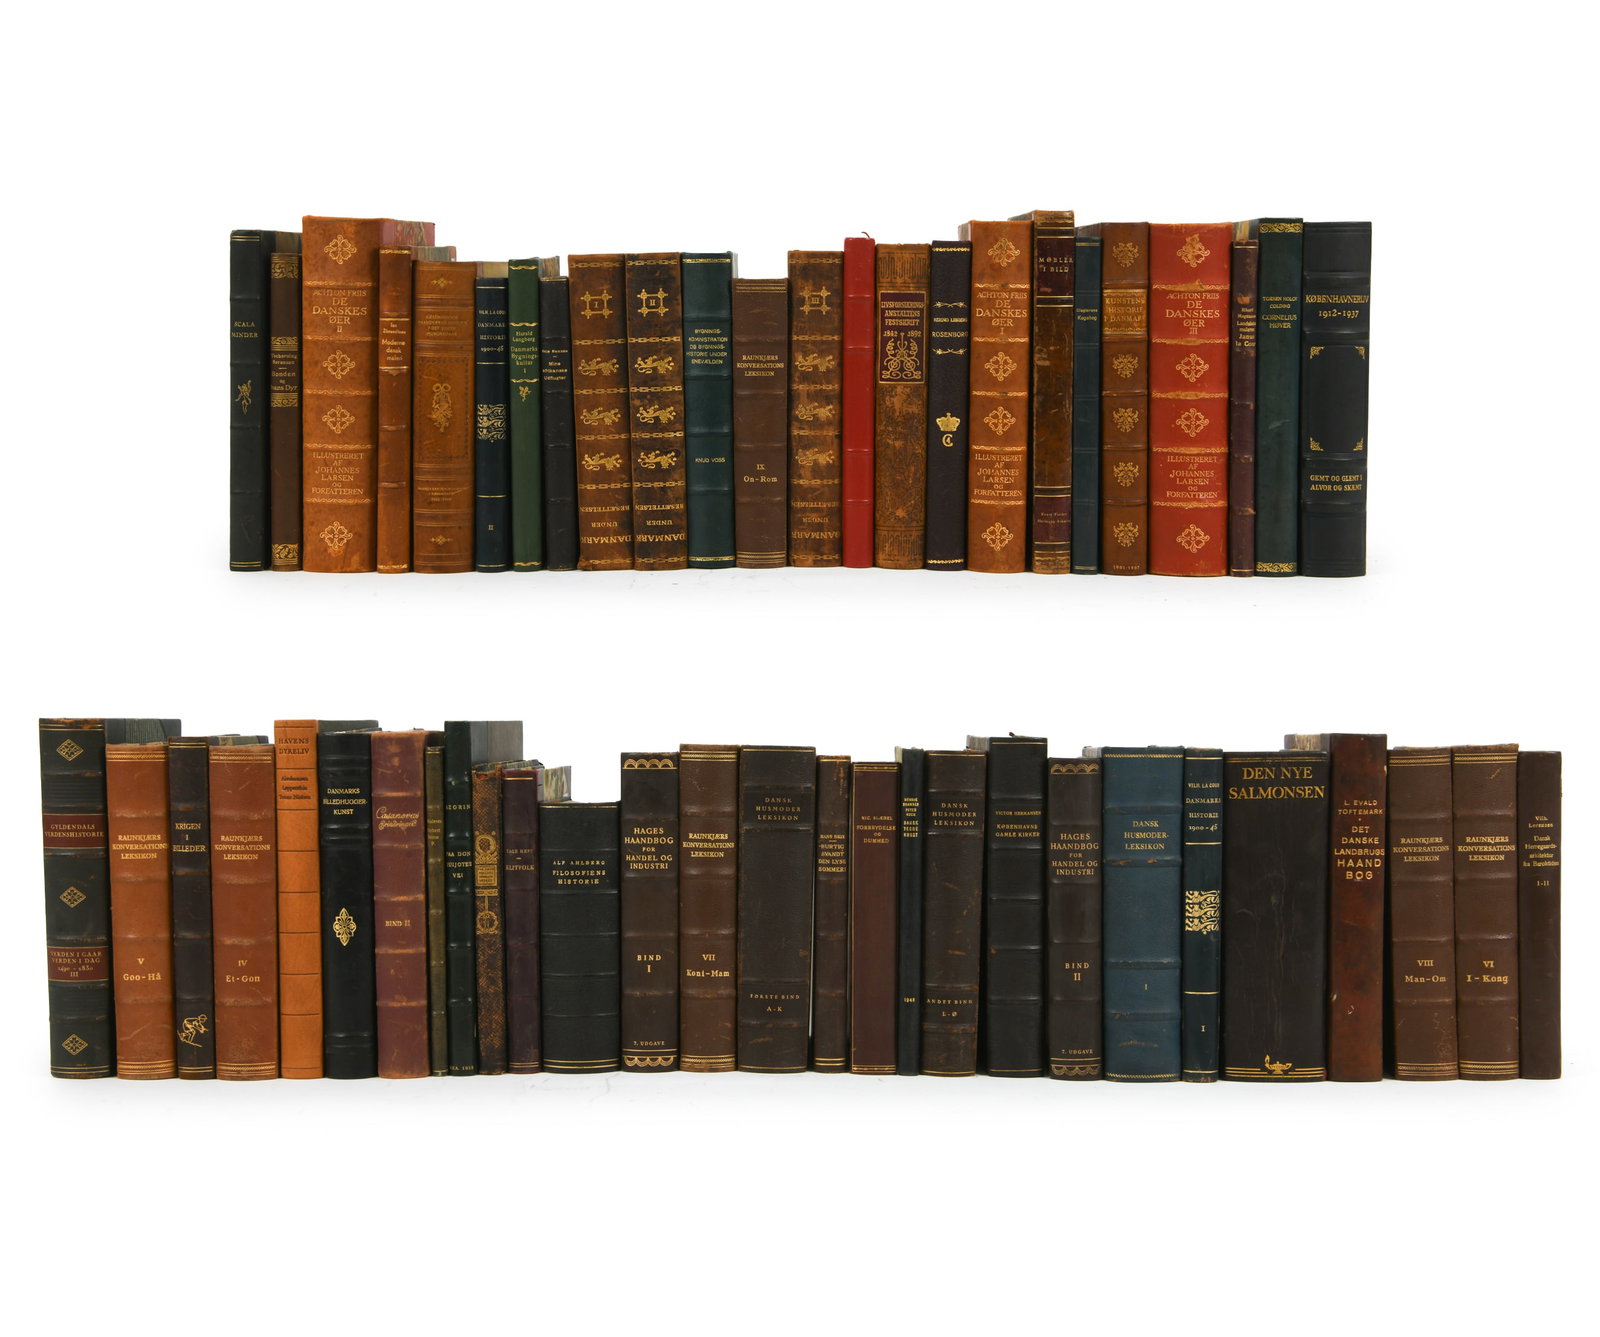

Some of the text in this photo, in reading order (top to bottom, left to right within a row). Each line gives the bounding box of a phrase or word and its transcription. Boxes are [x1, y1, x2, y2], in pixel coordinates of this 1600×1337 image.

[976, 291, 1028, 299] ACHTON FRIIS
[1166, 292, 1201, 300] ACHTON
[332, 297, 348, 306] DE
[995, 299, 1011, 308] DE
[1186, 300, 1203, 309] DE
[312, 306, 368, 316] DANSKES
[975, 308, 1028, 317] DANSKES
[1165, 309, 1220, 318] DANSKES
[1318, 308, 1360, 319] 1912-1937
[329, 316, 351, 325] ØER
[991, 317, 1014, 327] ØER
[1183, 318, 1206, 328] ØER
[999, 327, 1004, 335] I
[1189, 327, 1198, 335] III
[312, 451, 364, 460] ILLUSTRERET
[975, 453, 1023, 462] ILLUSTRERET
[1167, 455, 1217, 463] ILLUSTRERET
[315, 466, 360, 474] JOHANNES
[756, 463, 765, 471] IX
[976, 468, 1020, 477] JOHANNES
[1169, 470, 1215, 478] JOHANNES
[321, 473, 354, 481] LARSEN
[983, 476, 1015, 484] LARSEN
[1176, 477, 1209, 485] LARSEN
[311, 487, 364, 495] FORFATTEREN
[1333, 484, 1343, 492] OG
[974, 488, 1023, 497] FORFATTEREN
[1241, 766, 1313, 780] DEN NYE
[327, 787, 361, 795] DANMARKS
[1228, 785, 1326, 800] SALMONSEN
[333, 808, 354, 816] KUNST
[175, 822, 201, 830] KRIGEN
[1132, 820, 1160, 828] DANSK
[633, 827, 665, 835] HAGES
[1351, 825, 1370, 834] DET
[118, 834, 161, 842] RAUNKJÆRS
[220, 835, 263, 843] RAUNKJÆRS
[688, 832, 729, 841] RAUNKJÆRS
[1060, 833, 1091, 841] HAGES
[1124, 831, 1169, 839] HUSMODER-
[624, 836, 674, 844] HAANDBOG
[1341, 836, 1380, 845] DANSKE
[1399, 836, 1443, 845] RAUNKJÆRS
[1465, 835, 1509, 844] RAUNKJÆRS
[682, 841, 735, 849] KONVERSATIONS
[1050, 842, 1099, 850] HAANDBOG
[1125, 842, 1165, 851] LEKSIKON
[1392, 845, 1450, 853] KONVERSATIONS
[1457, 844, 1516, 852] KONVERSATIONS
[121, 852, 157, 860] LEKSIKON
[690, 850, 725, 858] LEKSIKON
[1334, 848, 1385, 856] LANDBRUGS
[1403, 854, 1440, 862] LEKSIKON
[630, 862, 669, 870] INDUSTRI
[1051, 860, 1085, 868] HANDEL
[1337, 858, 1382, 868] HAAND
[1055, 868, 1094, 876] INDUSTRI
[1345, 870, 1373, 880] BOG
[403, 919, 411, 927] II
[136, 957, 145, 965] V
[702, 953, 716, 961] VII
[238, 959, 248, 967] IV
[1416, 959, 1434, 967] VIII
[1482, 960, 1495, 968] VI
[647, 964, 652, 973] I
[686, 968, 730, 977] Koni-Mam
[123, 972, 162, 981] Goo-Hå
[1073, 972, 1081, 981] II
[1201, 1024, 1206, 1032] I
